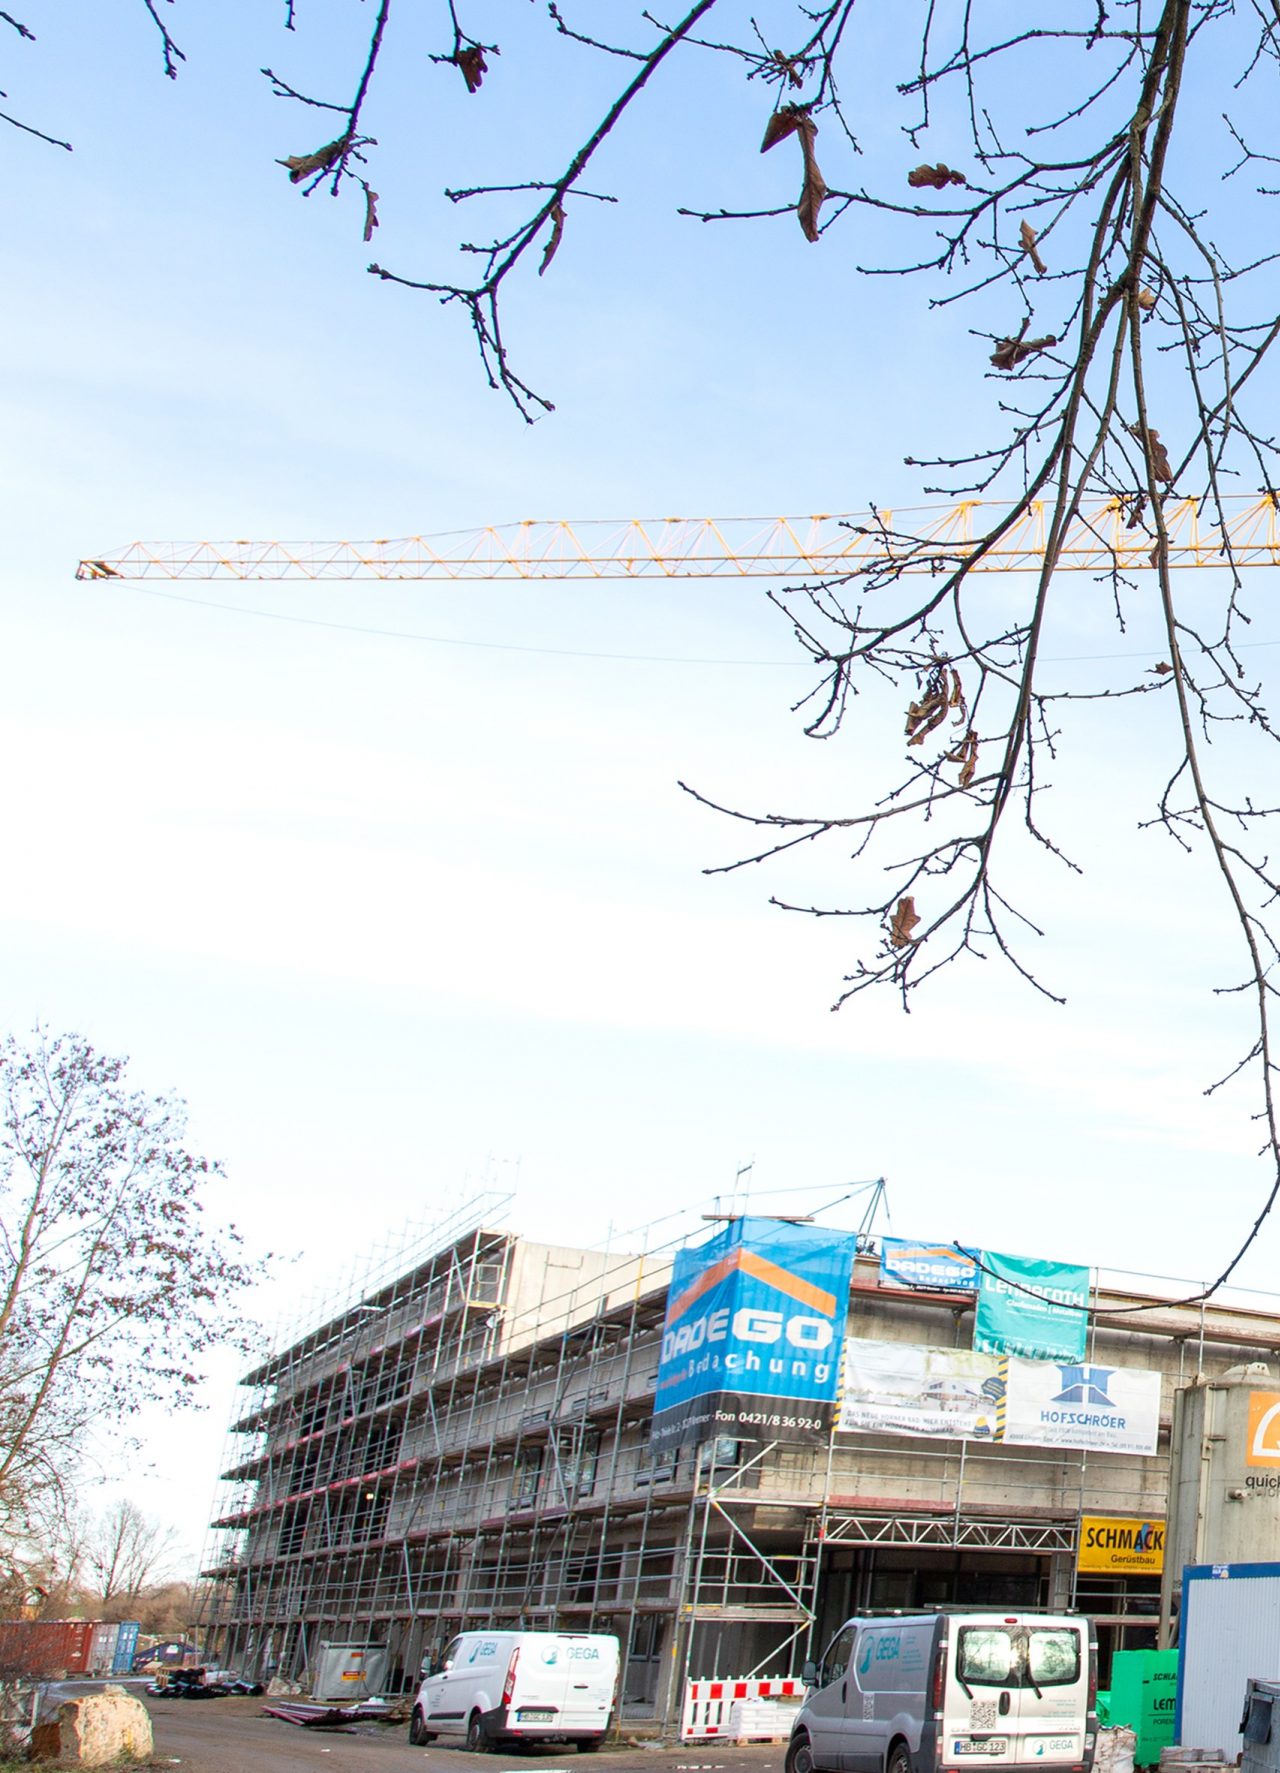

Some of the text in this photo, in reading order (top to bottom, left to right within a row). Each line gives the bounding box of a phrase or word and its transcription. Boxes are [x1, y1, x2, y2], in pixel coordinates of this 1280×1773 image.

[661, 1307, 834, 1365] DADEGO
[688, 1350, 830, 1384] Bedachung
[715, 1410, 736, 1422] Fon
[1040, 1410, 1126, 1429] HOFSCHRÖER
[1086, 1526, 1164, 1551] SCHMACK
[1111, 1553, 1156, 1565] Gerüstbau
[567, 1647, 600, 1660] GEGA
[876, 1636, 901, 1660] GEGA
[960, 1742, 972, 1752] HB
[976, 1742, 989, 1752] GC
[1048, 1739, 1073, 1751] GEGA
